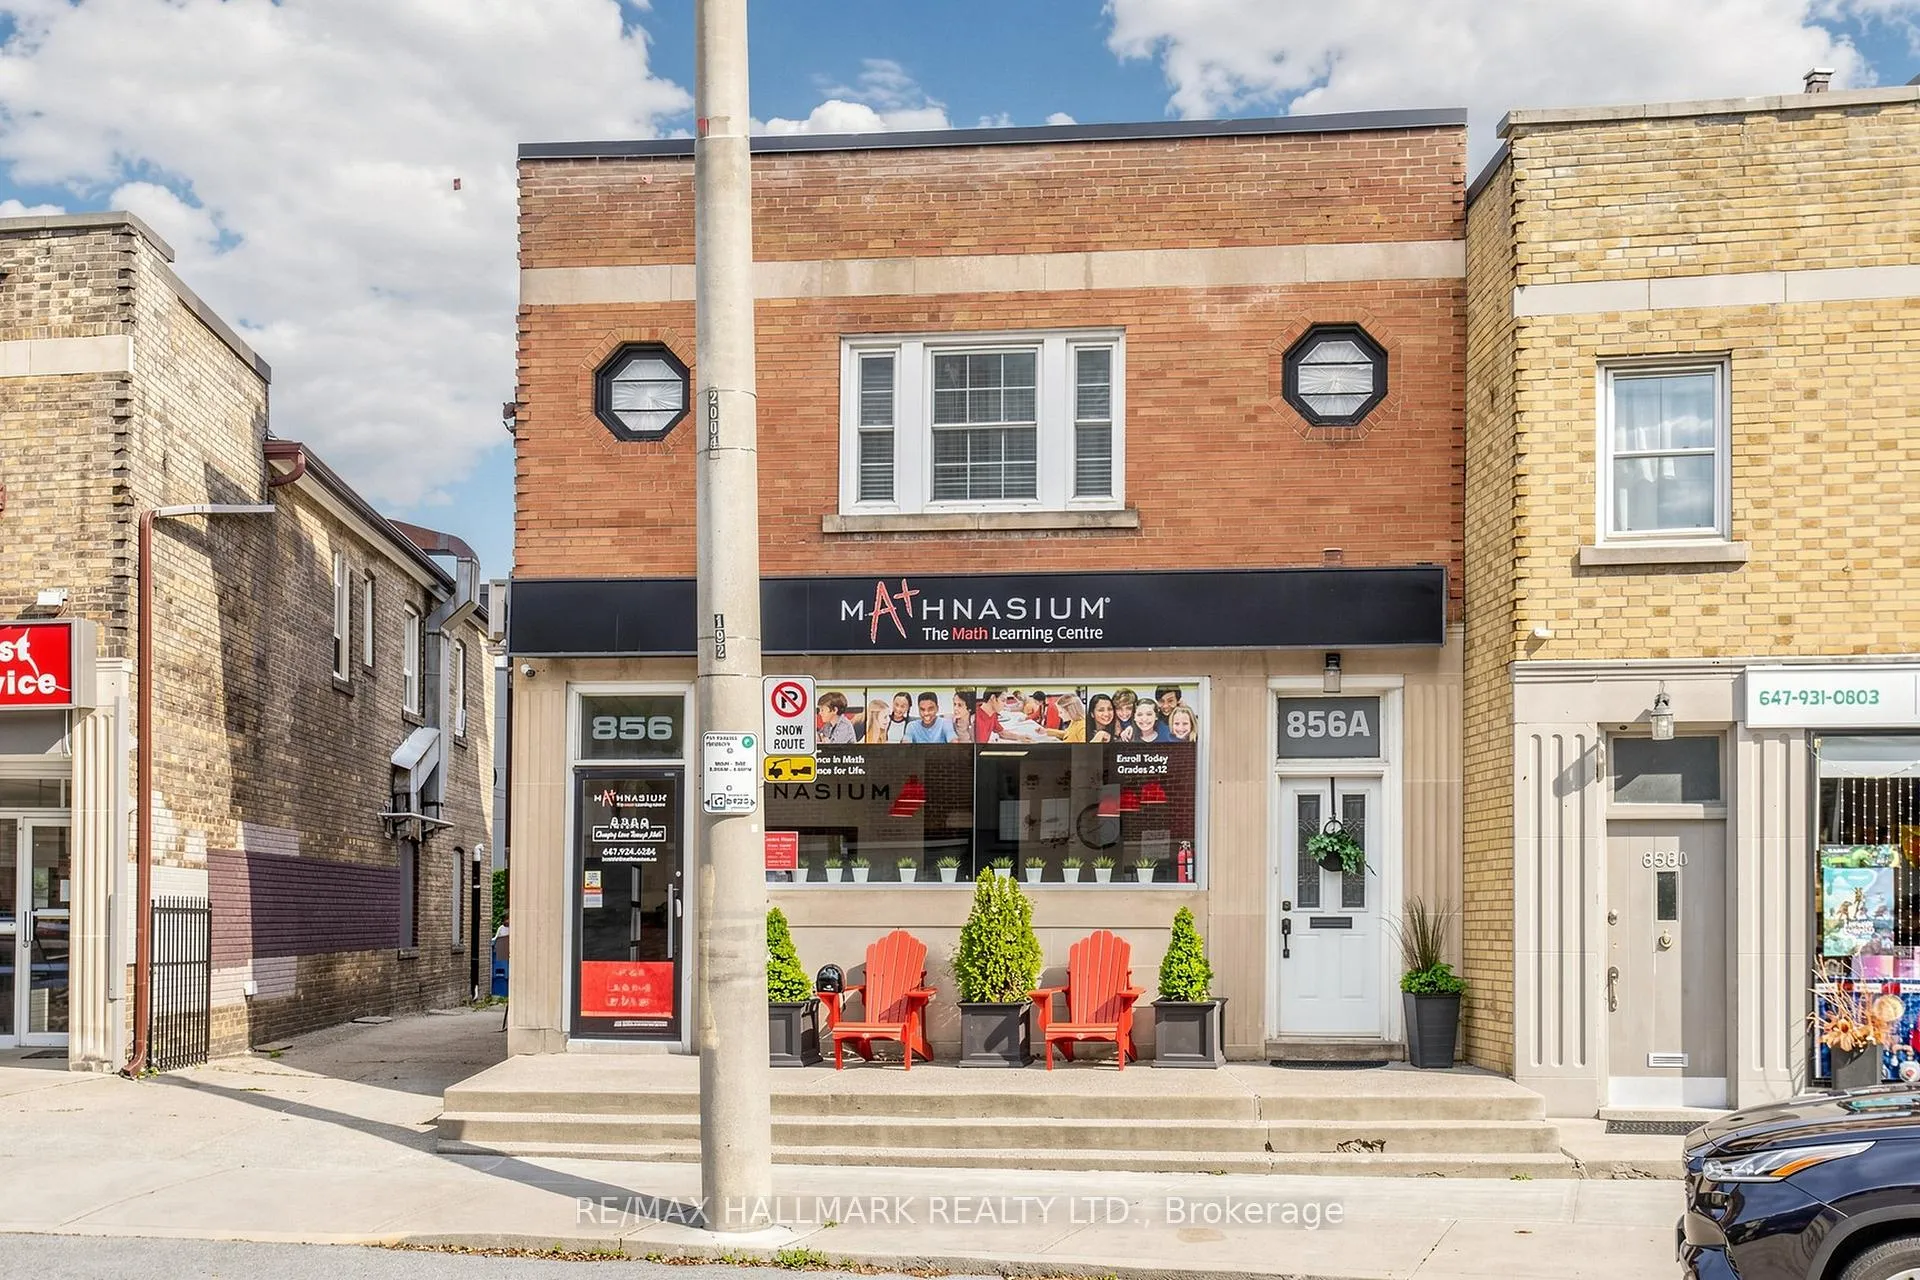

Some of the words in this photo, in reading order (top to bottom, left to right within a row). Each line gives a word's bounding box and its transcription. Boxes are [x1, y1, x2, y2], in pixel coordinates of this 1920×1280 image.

[714, 614, 726, 658] 192
[923, 627, 949, 640] The
[952, 626, 988, 640] Math
[992, 626, 1053, 643] Learning
[1057, 626, 1103, 640] Centre
[1759, 689, 1880, 706] 647-931-0803
[592, 716, 672, 740] 856
[776, 725, 803, 736] SNOW
[1286, 710, 1371, 738] 856A
[774, 738, 805, 750] ROUTE
[1116, 754, 1141, 763] Enroll
[1143, 754, 1168, 764] Today
[833, 766, 847, 775] for
[1117, 766, 1148, 774] Grades
